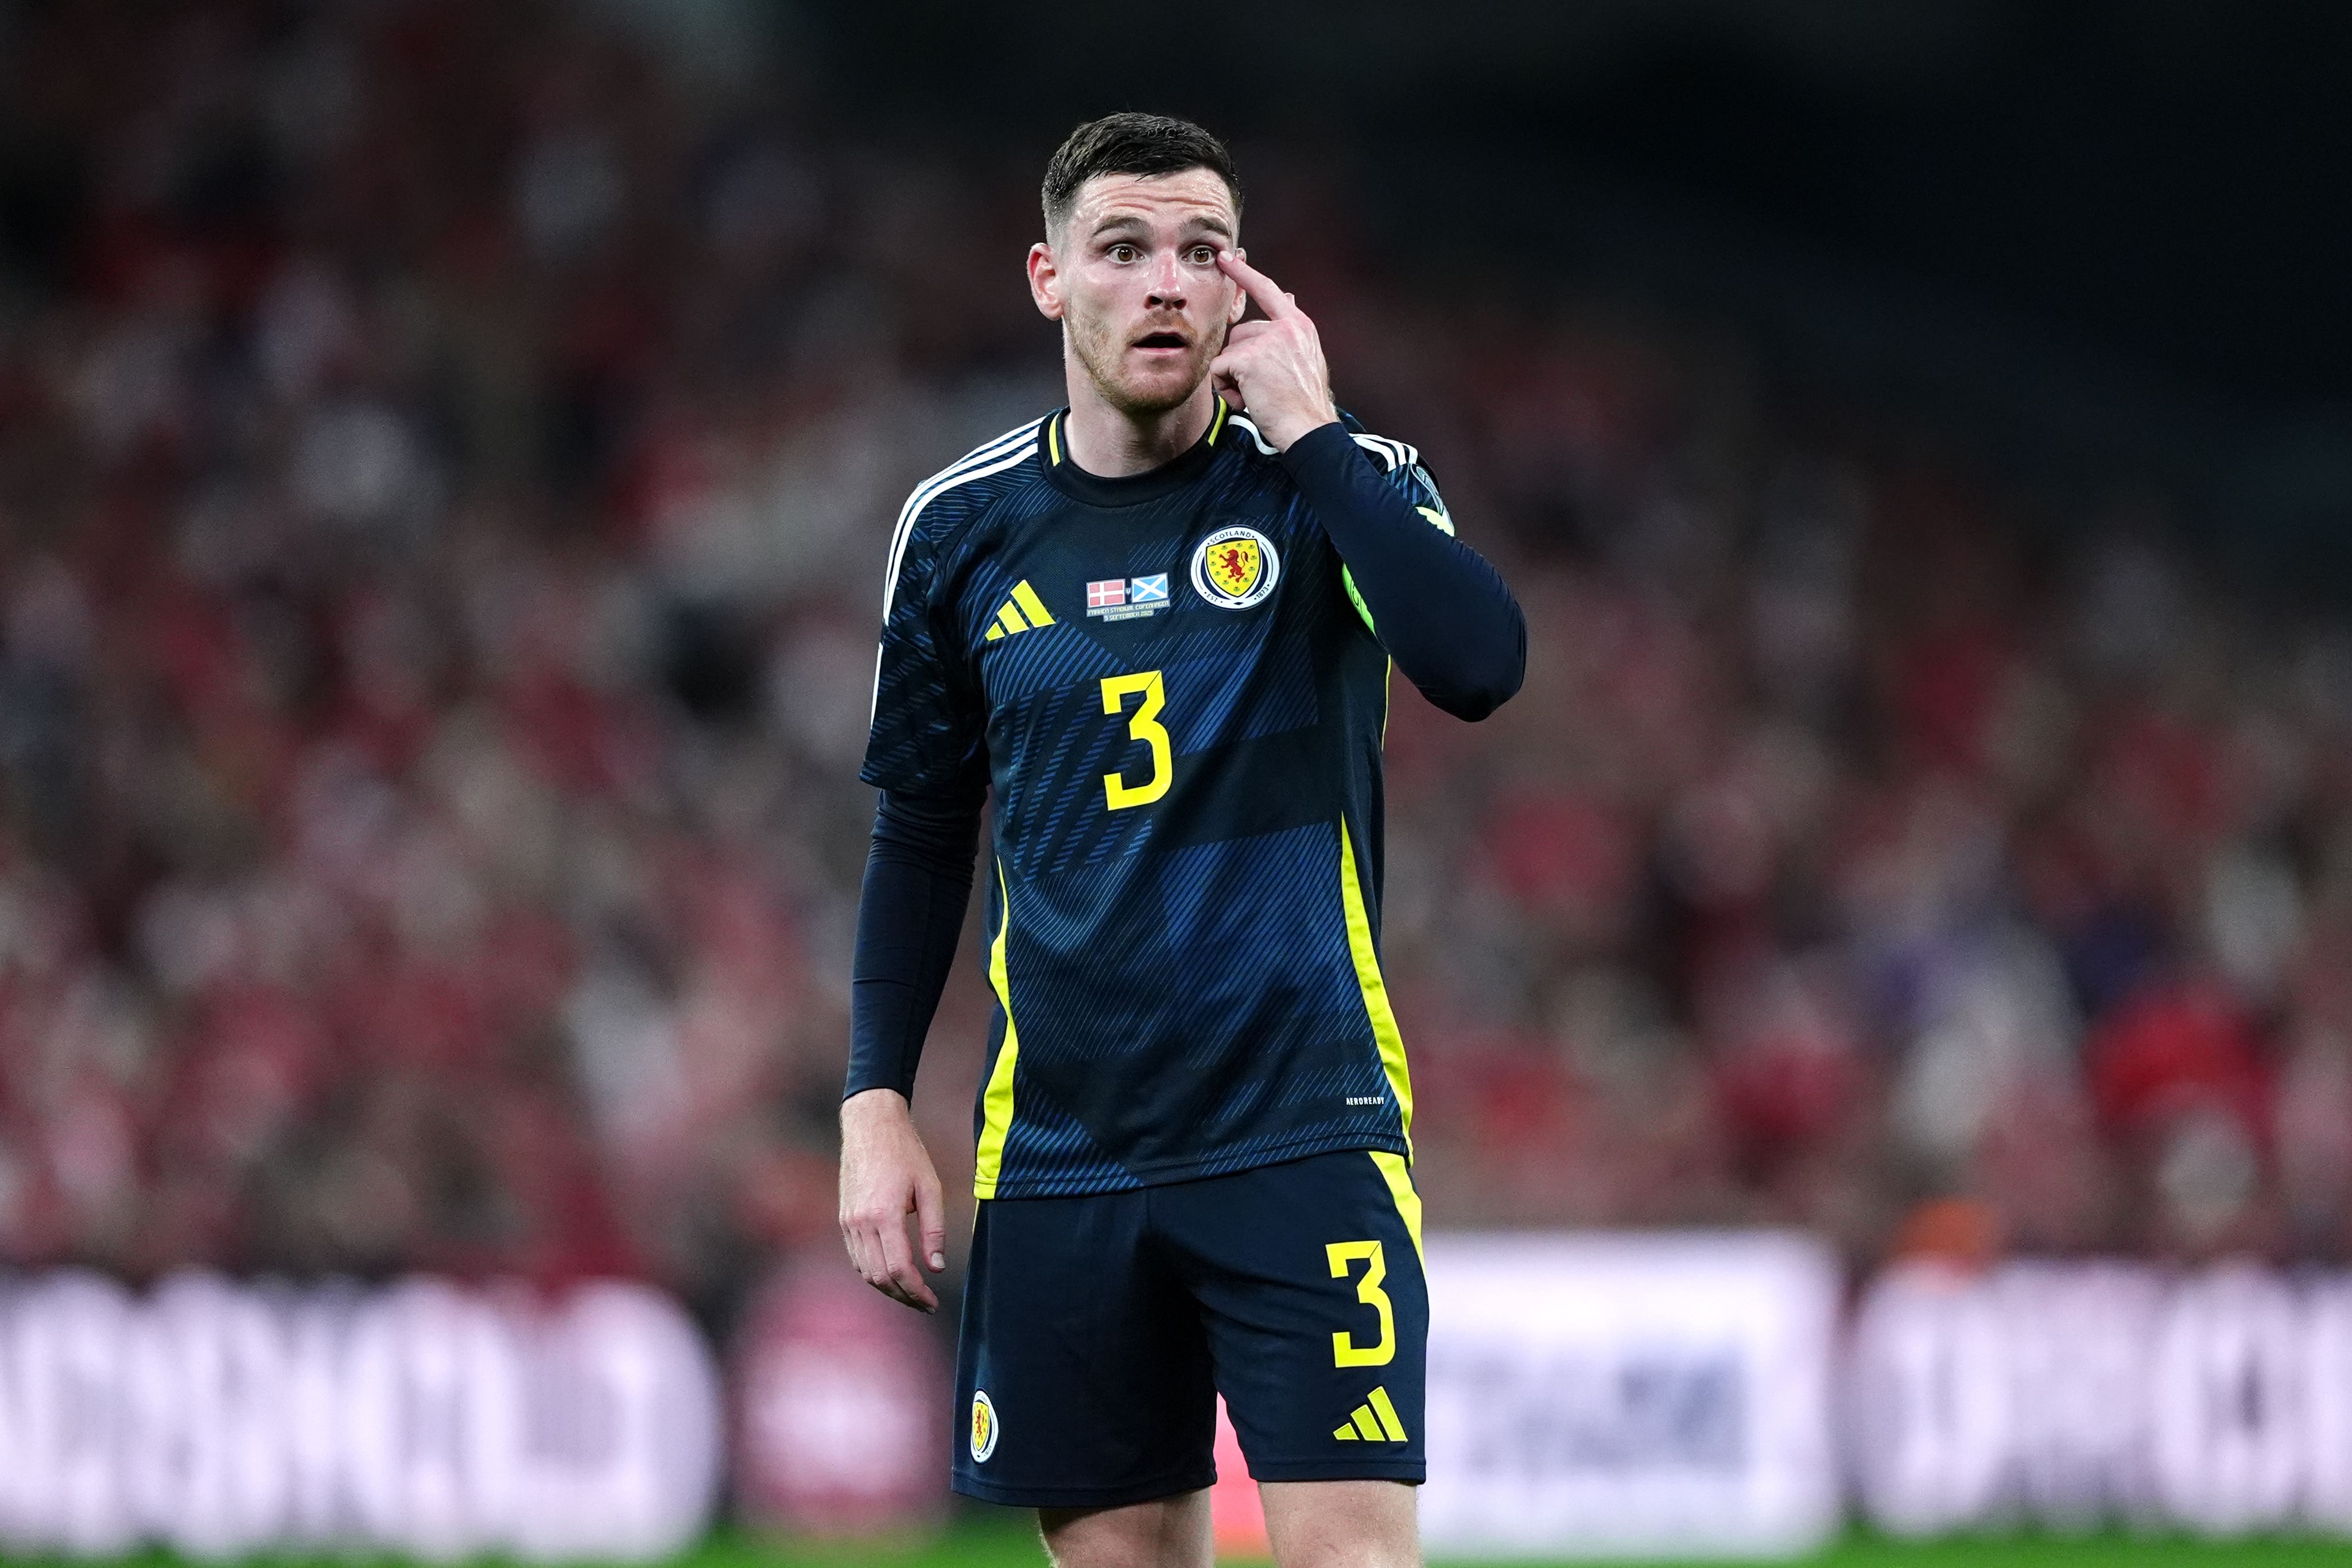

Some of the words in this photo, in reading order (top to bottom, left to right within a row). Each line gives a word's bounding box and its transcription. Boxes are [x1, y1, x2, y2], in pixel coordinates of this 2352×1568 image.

[1210, 530, 1251, 544] SCOTLAND
[1206, 593, 1218, 602] EST
[1256, 587, 1269, 598] 1873
[1101, 671, 1173, 810] 3
[1346, 1097, 1384, 1105] AEROREADY
[1326, 1240, 1395, 1367] 3
